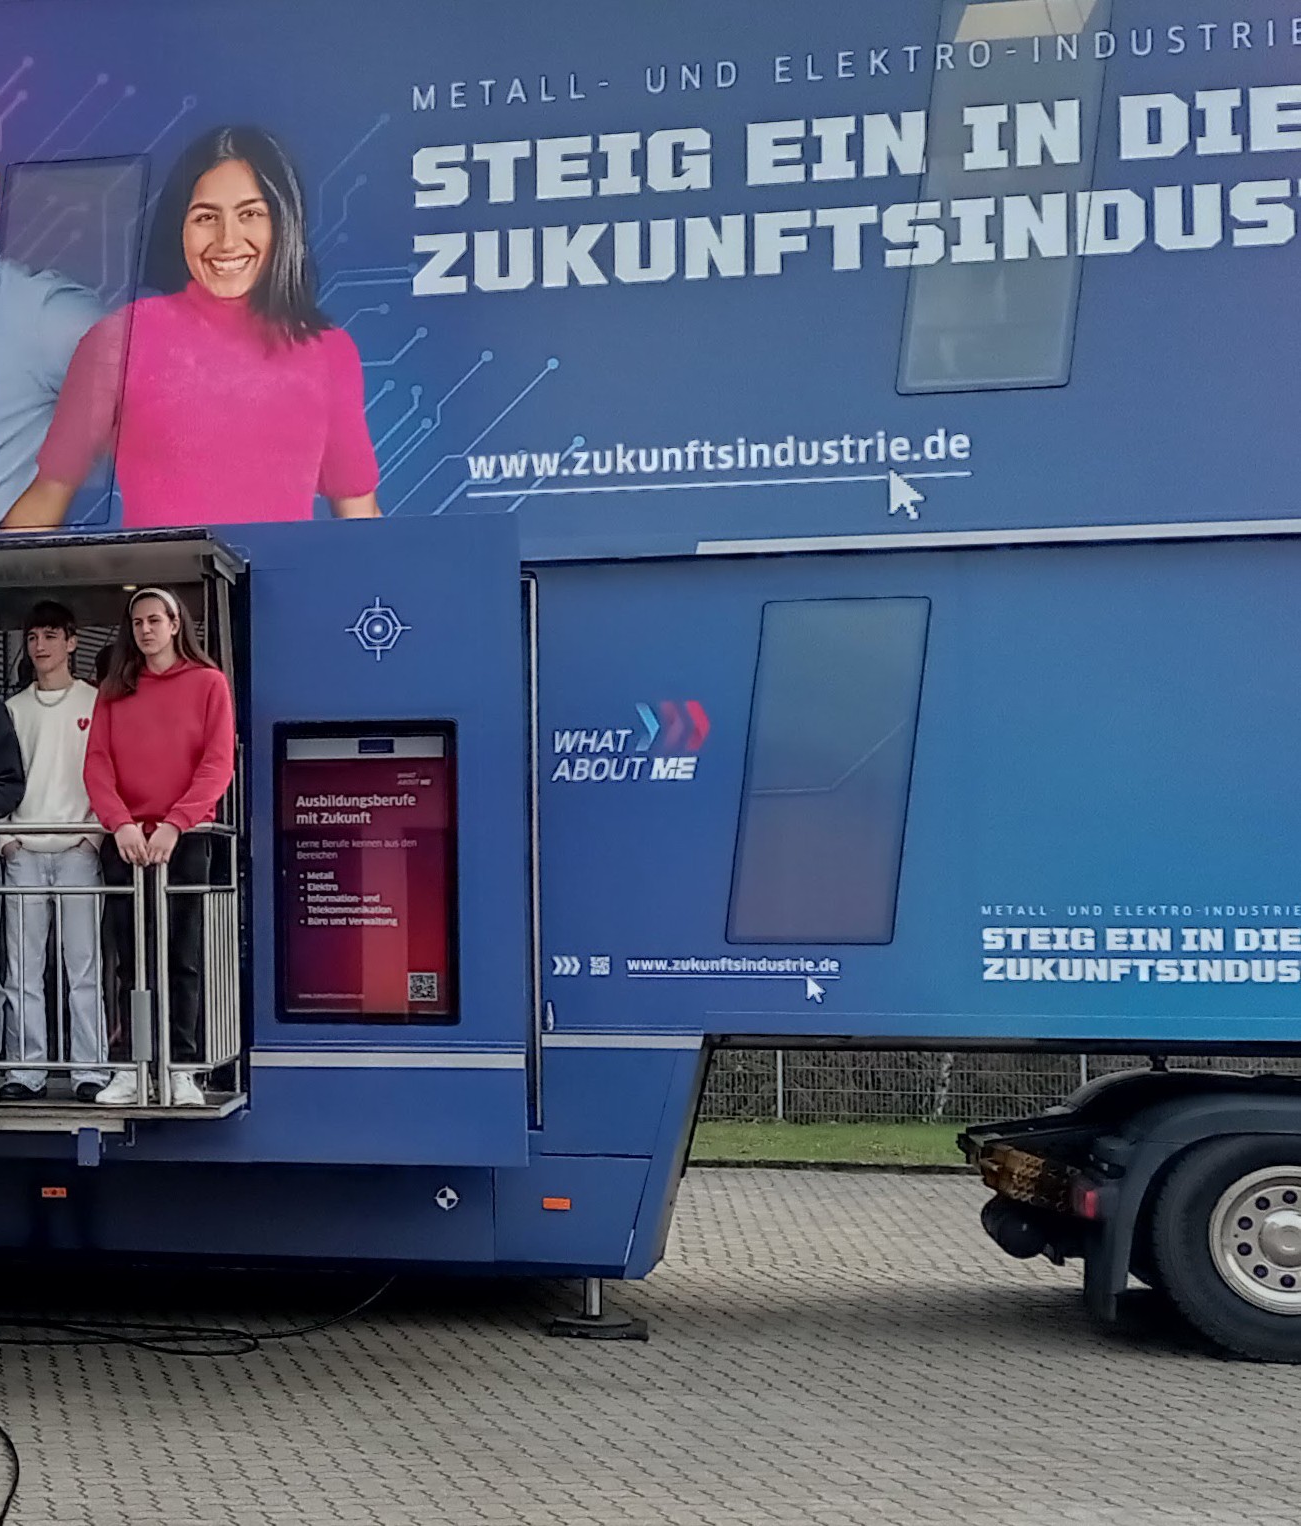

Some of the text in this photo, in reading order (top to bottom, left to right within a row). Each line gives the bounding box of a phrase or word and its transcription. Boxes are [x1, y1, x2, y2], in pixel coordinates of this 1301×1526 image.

[411, 17, 1301, 112] METALL- UND ELEKTRO-INDUSTRIE
[411, 84, 1301, 209] STEIG EIN IN DIE
[411, 177, 1301, 297] ZUKUNFTSINDUS
[467, 427, 972, 479] www.zukunftsindustrie.de
[553, 729, 633, 754] WHAT
[551, 756, 698, 782] ABOUT ME
[295, 793, 417, 809] Ausbildungsberufe
[296, 811, 372, 825] mit Zukunft
[296, 838, 418, 849] Lerne Berufe kennen aus den
[296, 850, 339, 860] Bereichen
[307, 871, 335, 880] Metall
[307, 882, 339, 892] Elektro
[362, 893, 381, 903] und
[307, 905, 393, 914] Telekommunikation
[980, 905, 1301, 916] METALL- UND ELEKTRO-INDUSTRIE
[307, 916, 399, 927] Büro und Verwaltung
[982, 927, 1301, 952] STEIG EIN IN DIE
[626, 956, 840, 972] www.zukunftsindustrie.de
[982, 957, 1301, 983] ZUKUNFTSINDUS
